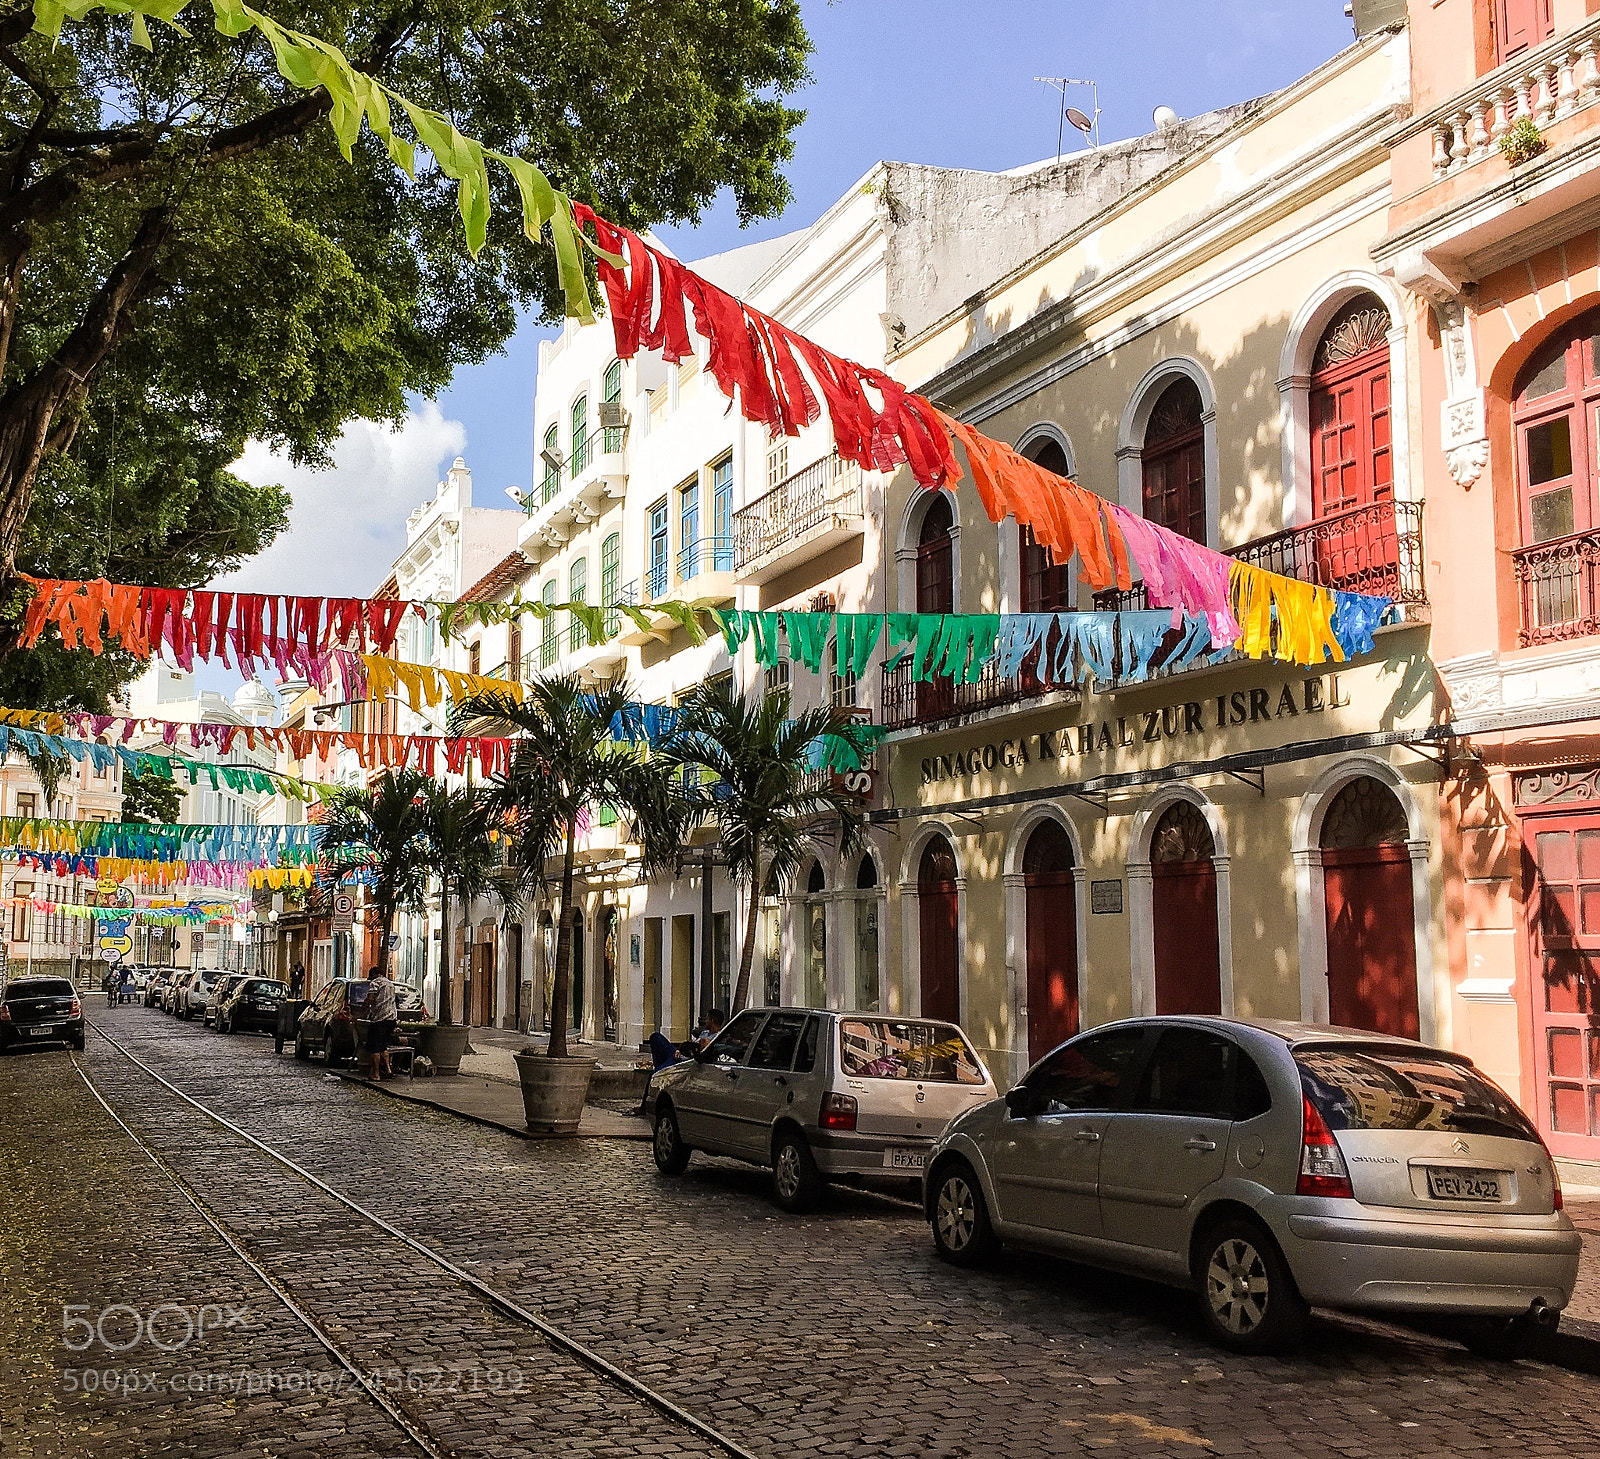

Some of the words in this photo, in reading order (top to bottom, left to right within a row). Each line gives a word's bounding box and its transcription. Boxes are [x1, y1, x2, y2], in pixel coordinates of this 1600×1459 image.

[921, 738, 1029, 784] SINAGOGA
[1038, 716, 1134, 760] KAHAL
[1143, 702, 1204, 743] ZUR
[1216, 673, 1351, 727] ISRAEL
